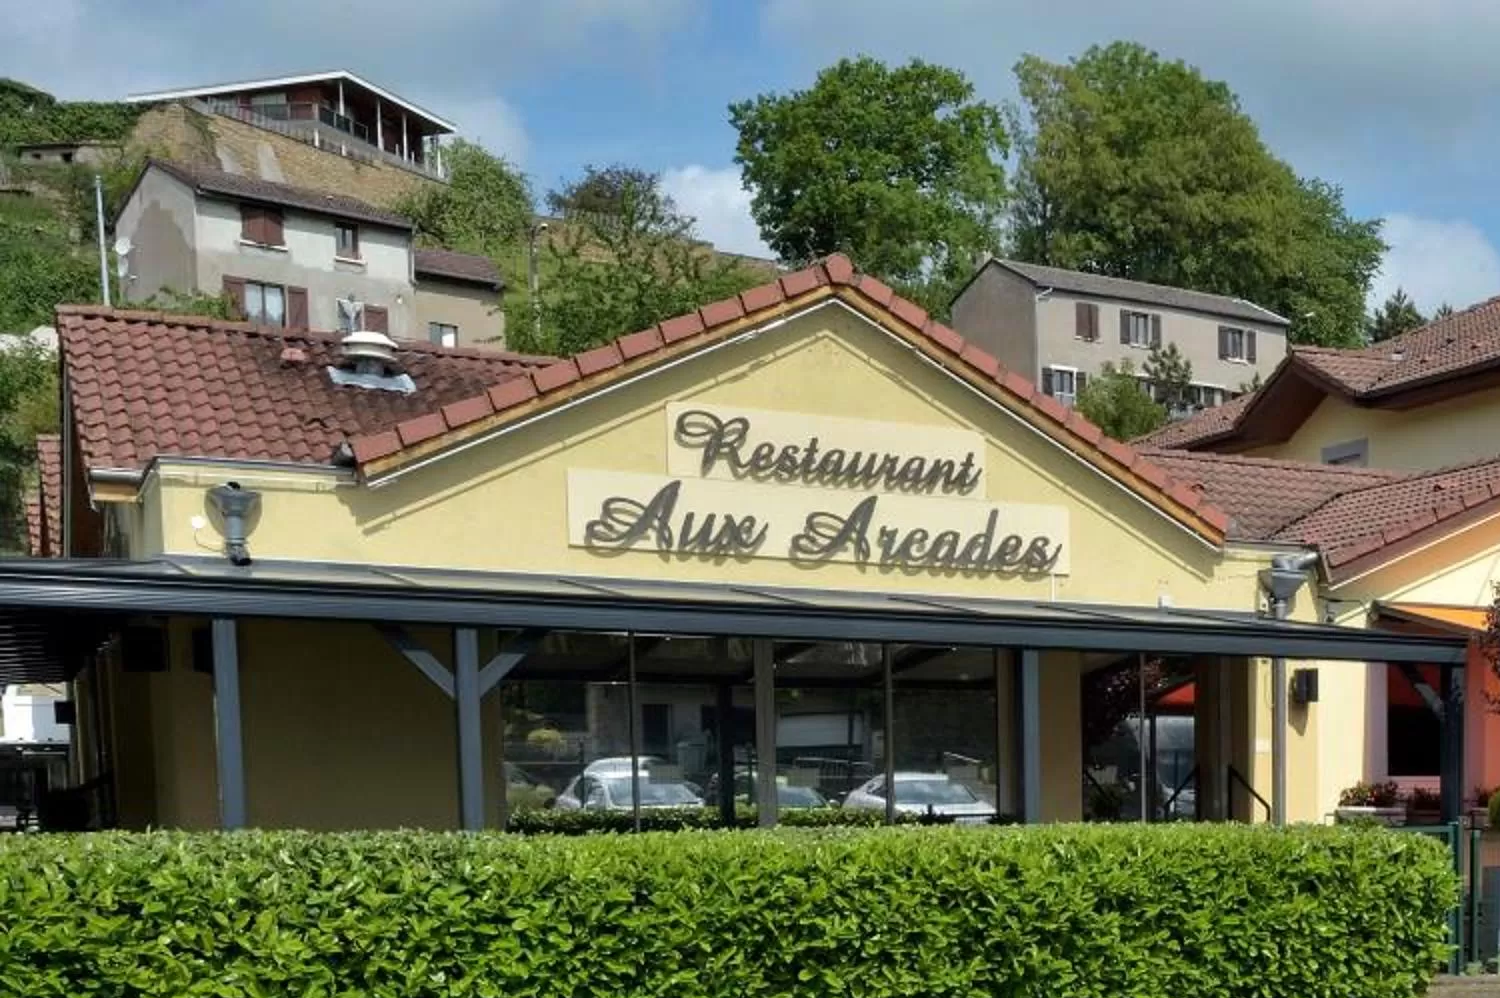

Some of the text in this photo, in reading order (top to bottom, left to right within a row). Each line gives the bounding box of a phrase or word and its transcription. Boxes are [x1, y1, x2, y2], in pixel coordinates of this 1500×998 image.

[674, 409, 983, 493] Restaurant
[585, 479, 1064, 575] Aux Arcades
